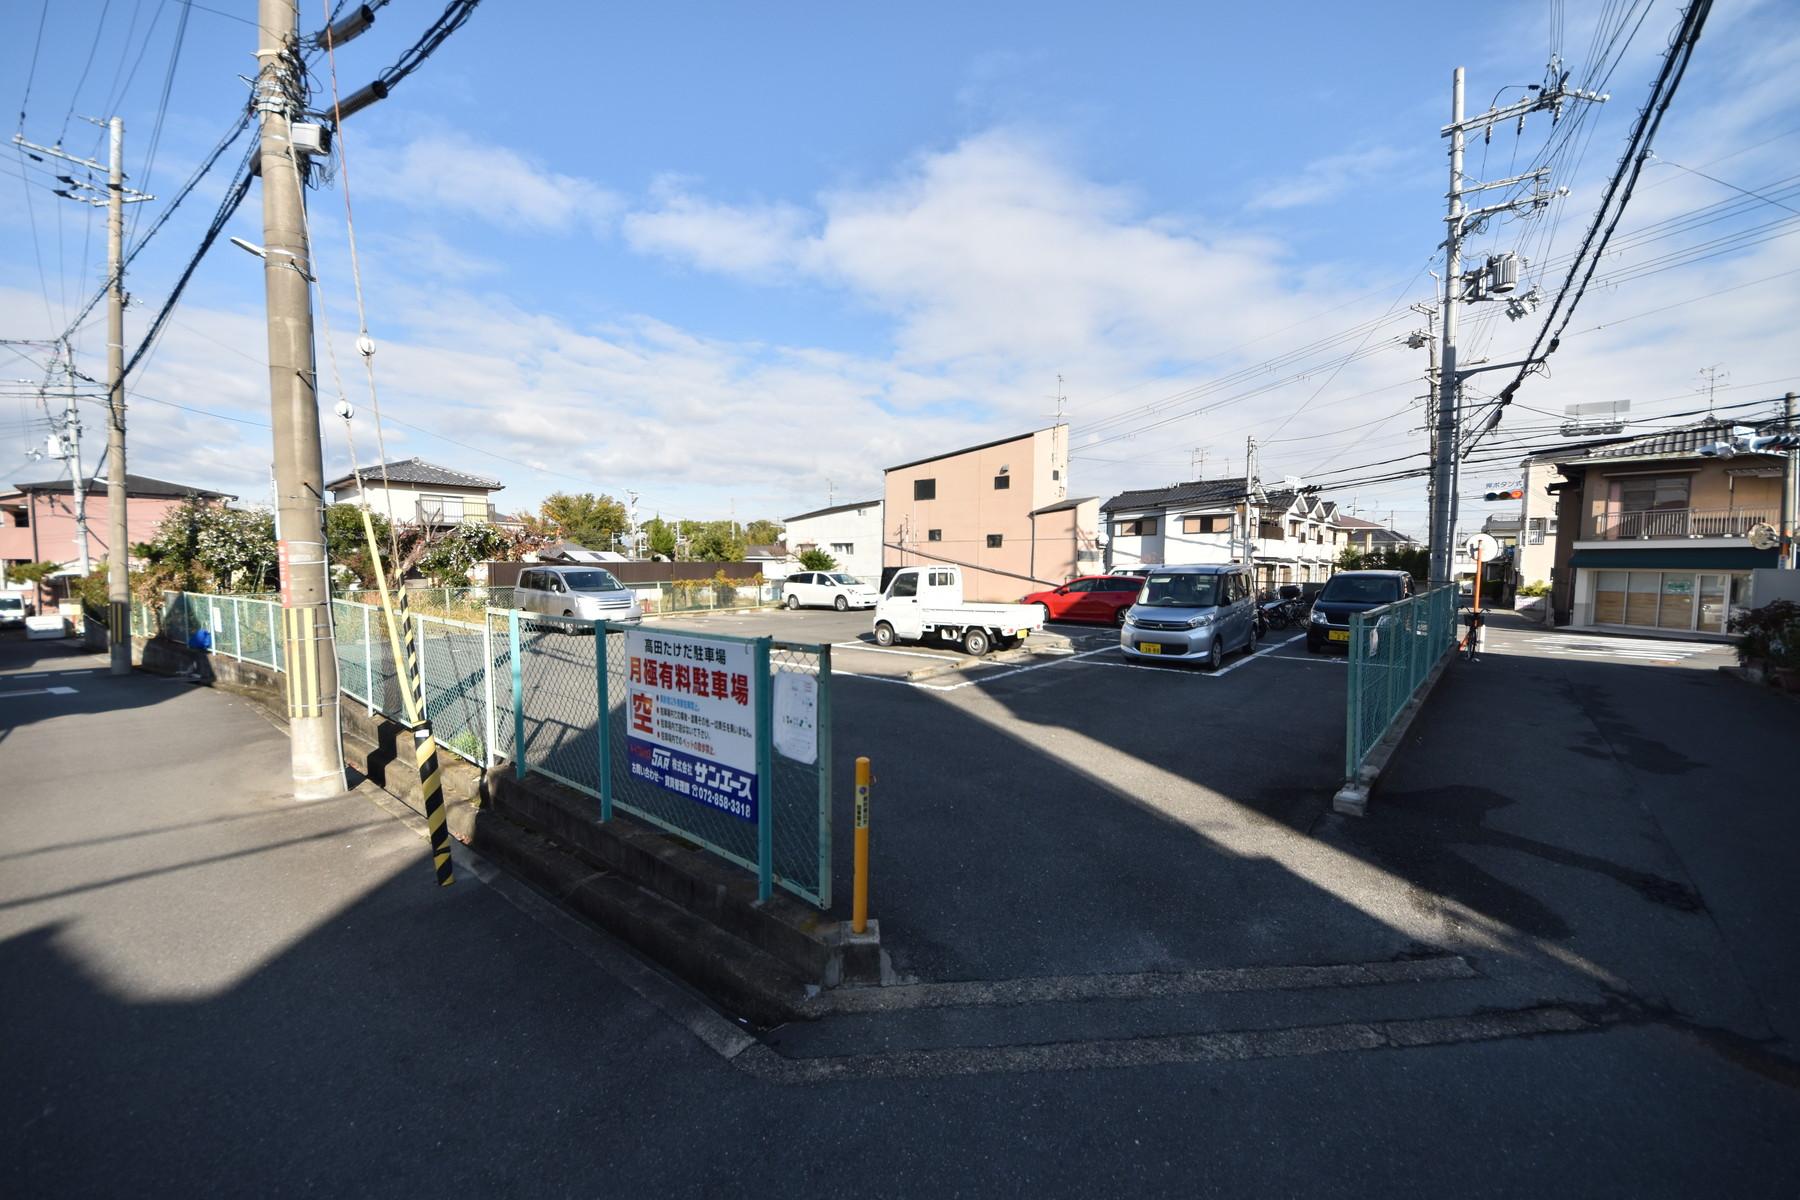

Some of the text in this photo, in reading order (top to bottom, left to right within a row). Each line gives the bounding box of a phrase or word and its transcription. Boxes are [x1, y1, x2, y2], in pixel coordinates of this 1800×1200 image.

[644, 638, 727, 665] 高田たけだ駐車場
[630, 656, 749, 706] 月極有料駐車場
[633, 692, 653, 734] 空
[672, 758, 693, 776] 株式会社
[695, 761, 752, 800] サンエース
